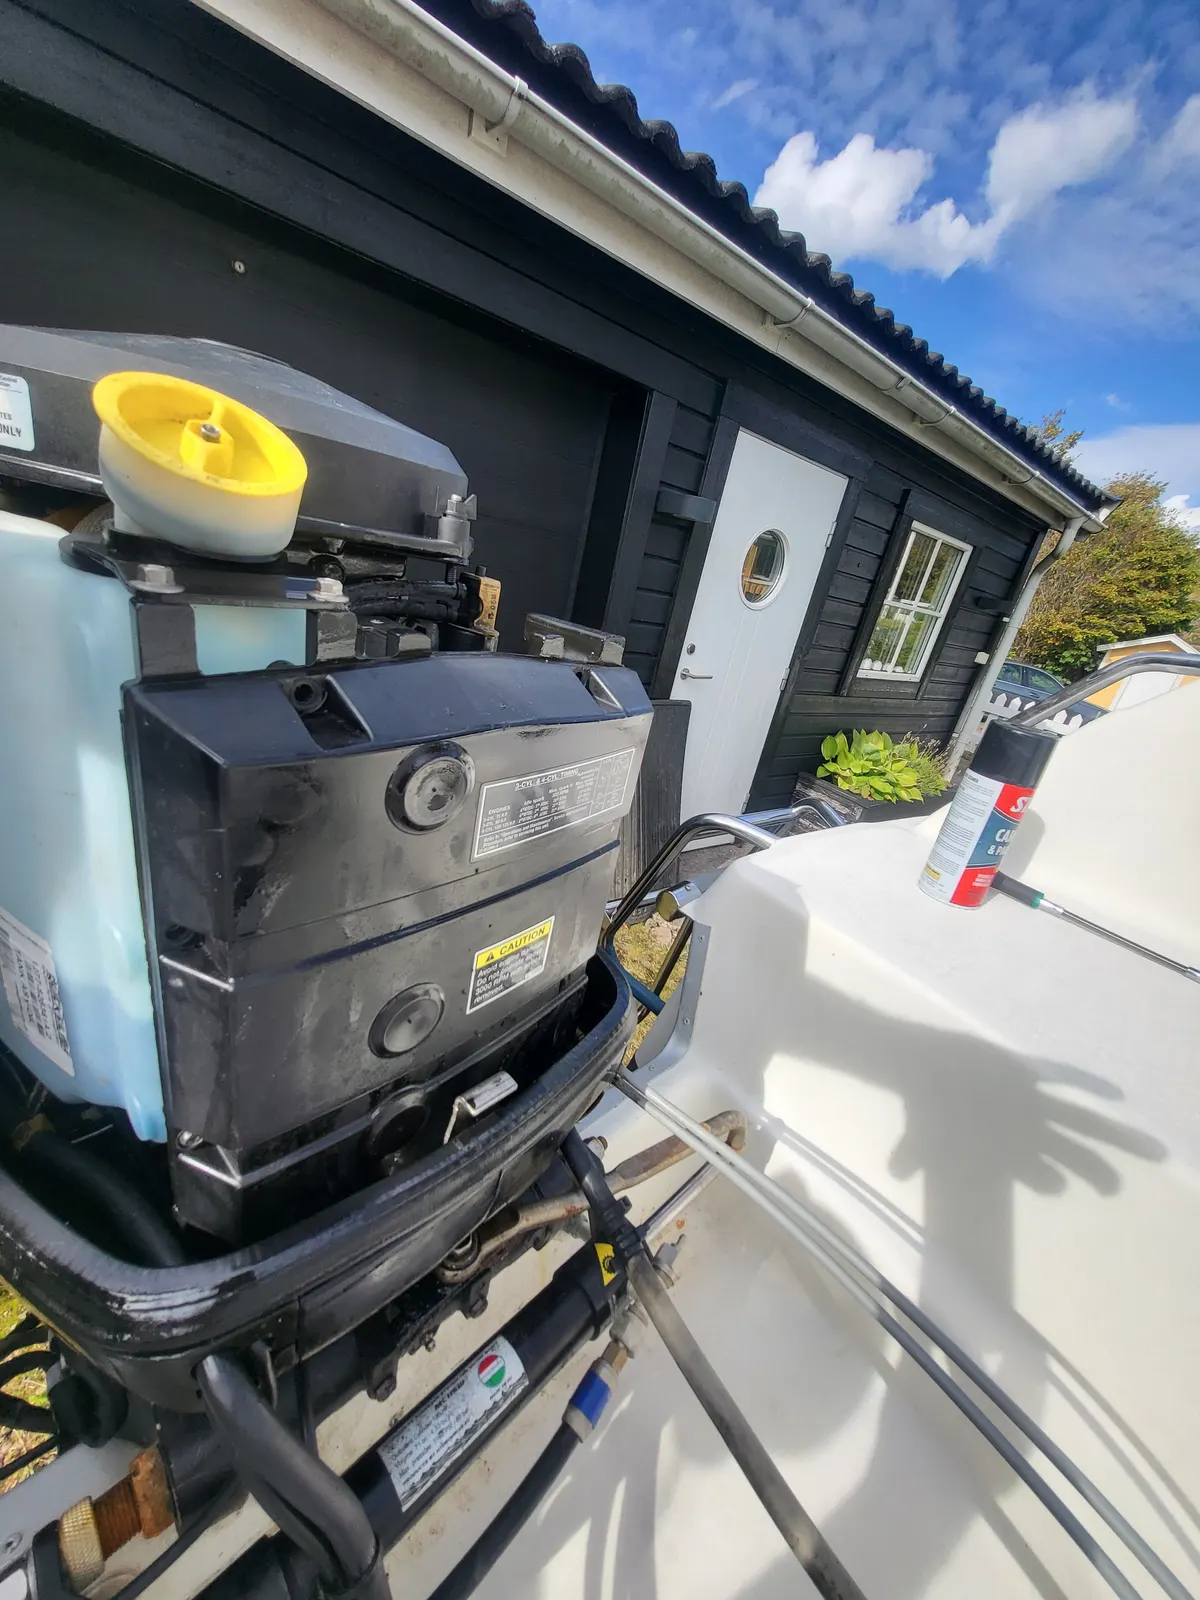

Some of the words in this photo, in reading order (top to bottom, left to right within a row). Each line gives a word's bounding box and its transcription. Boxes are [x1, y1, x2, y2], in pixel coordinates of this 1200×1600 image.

[561, 768, 579, 778] TIMING
[488, 804, 511, 815] ENGINES
[500, 926, 546, 956] CAUTION
[478, 963, 498, 978] Avoid
[475, 983, 492, 995] 3000
[493, 972, 511, 986] RPM
[476, 977, 486, 987] Do
[488, 971, 500, 982] not
